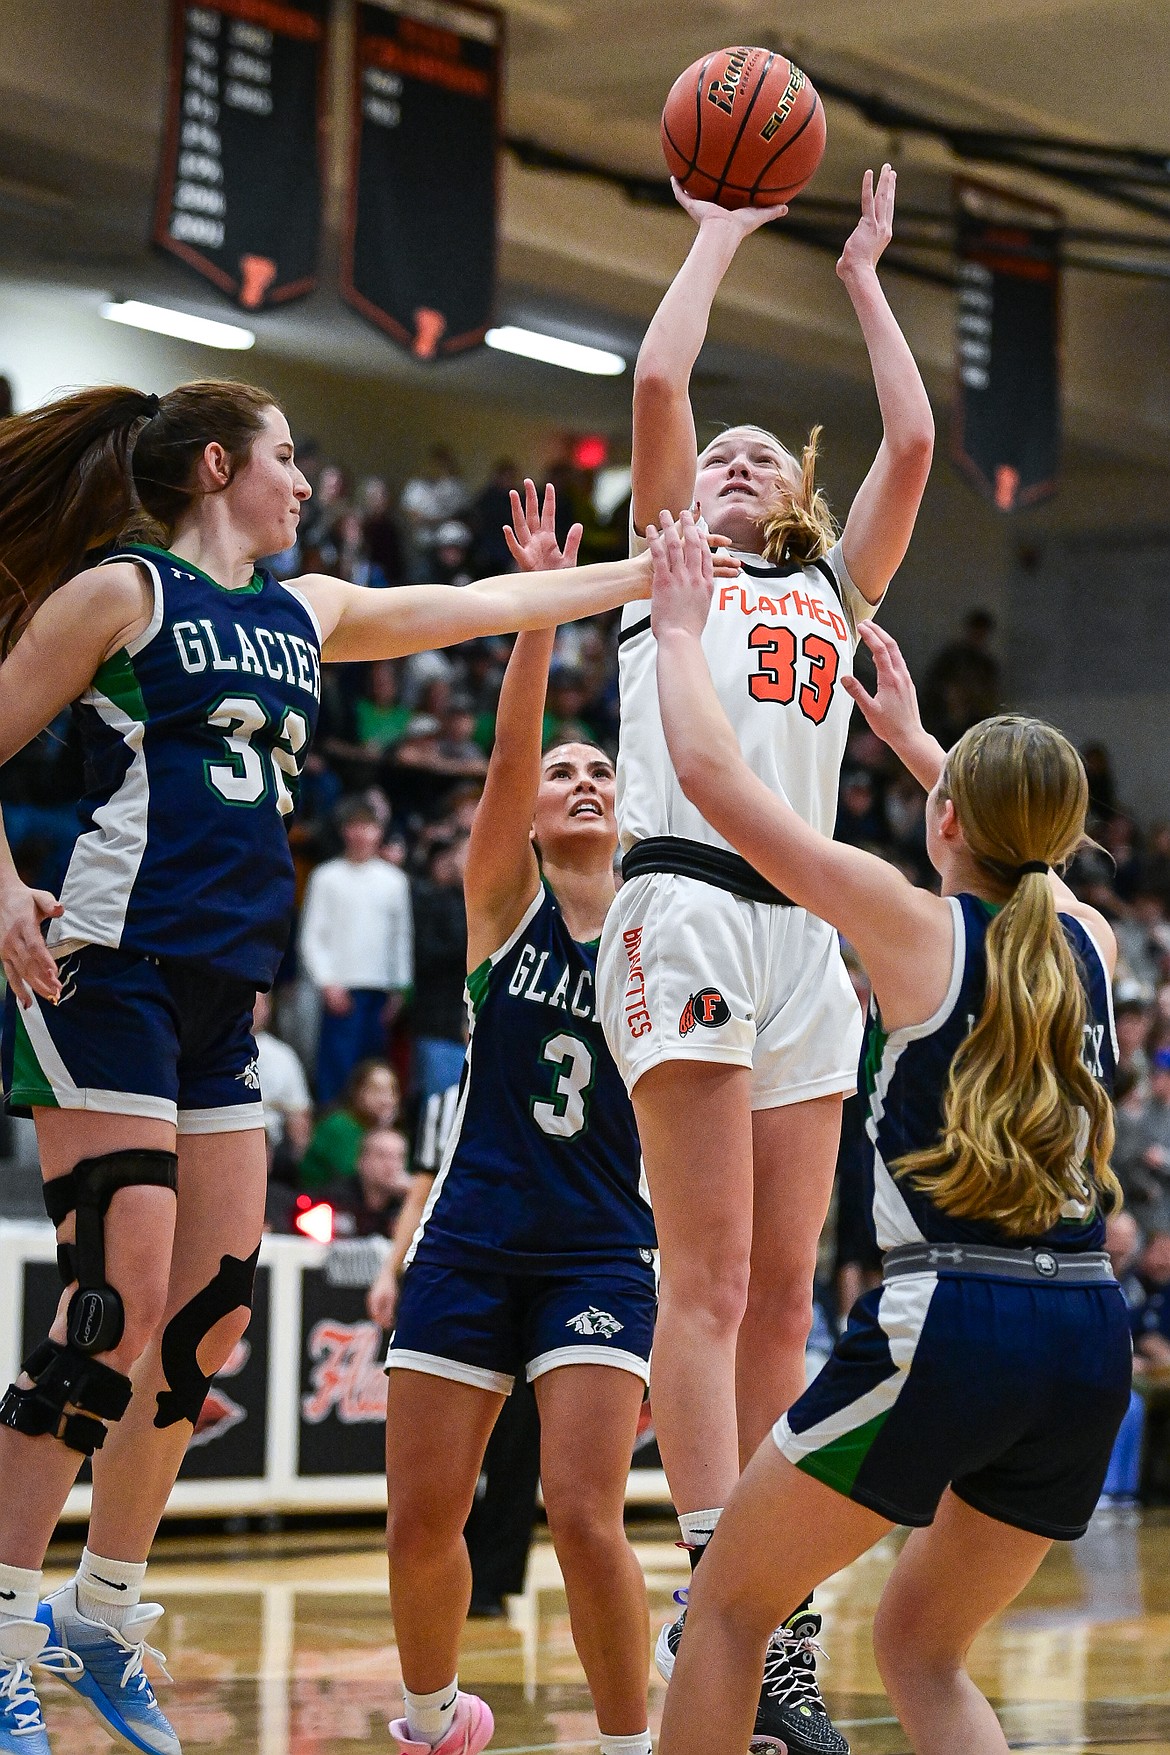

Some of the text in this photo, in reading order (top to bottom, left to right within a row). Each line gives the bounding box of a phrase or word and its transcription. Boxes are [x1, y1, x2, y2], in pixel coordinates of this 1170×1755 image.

[747, 622, 840, 726] 33
[508, 943, 602, 1023] GLAC
[701, 993, 722, 1022] F
[530, 1029, 597, 1142] 3
